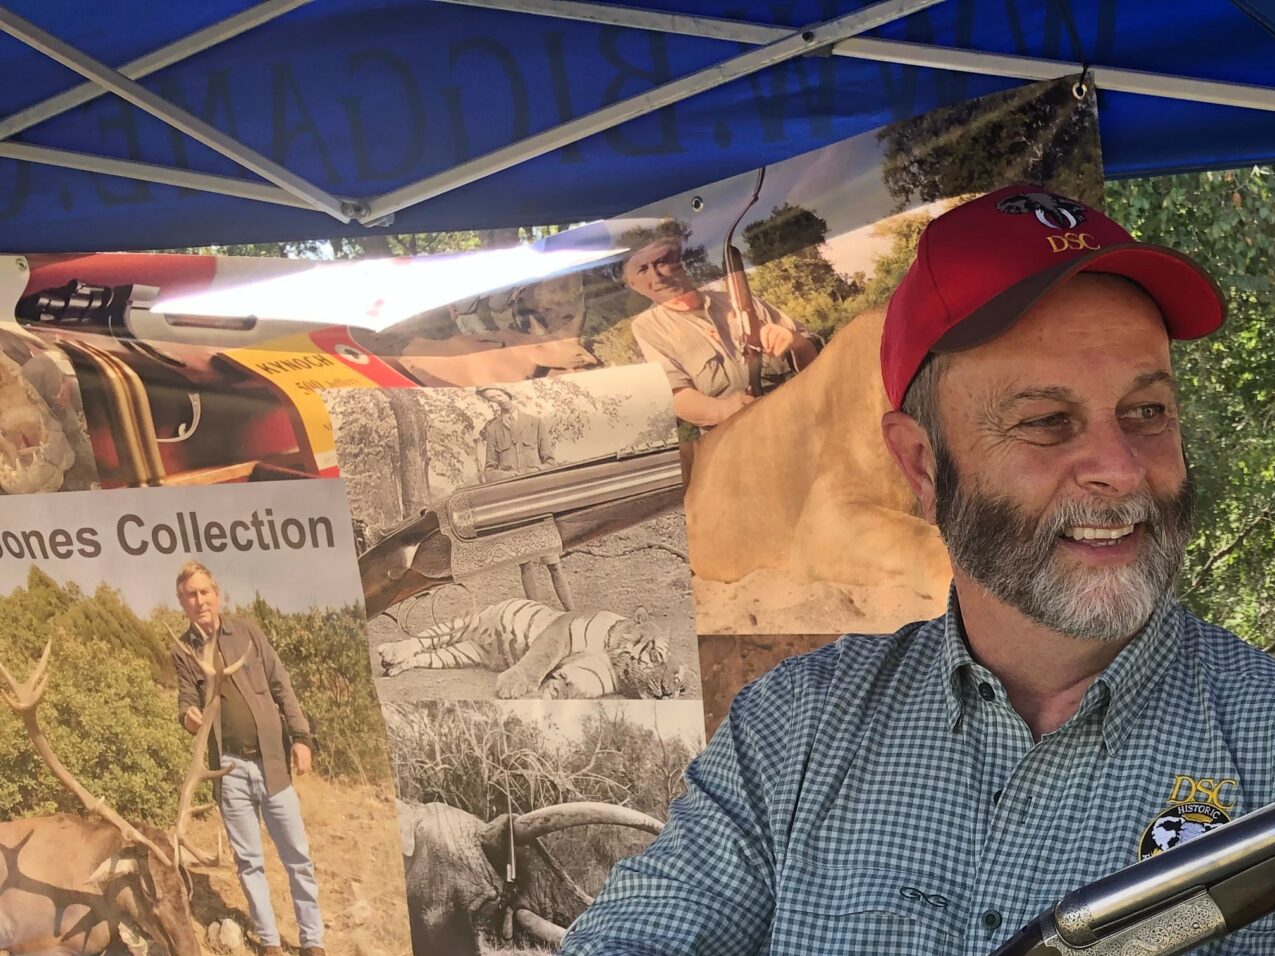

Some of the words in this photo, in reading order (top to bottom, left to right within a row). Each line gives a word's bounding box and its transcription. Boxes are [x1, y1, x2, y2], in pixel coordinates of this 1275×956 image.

[1045, 232, 1101, 253] DSC
[255, 354, 334, 375] KYNOCH
[0, 527, 102, 560] ones
[116, 508, 336, 556] Collection
[1167, 774, 1238, 812] DSC
[1178, 804, 1220, 819] HISTORIC
